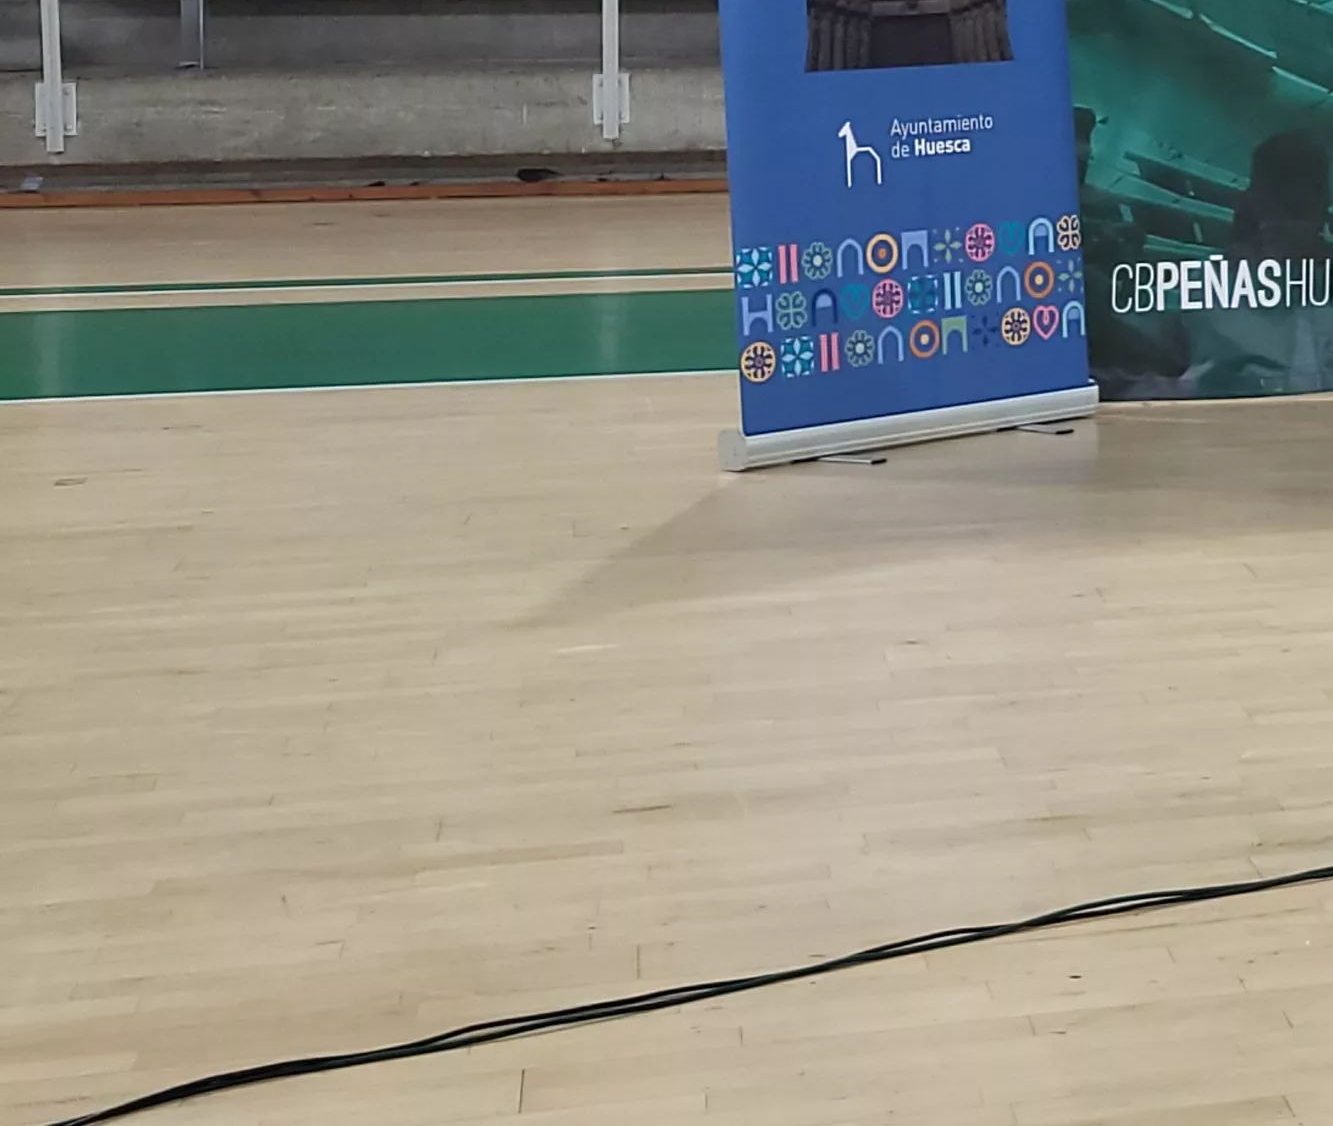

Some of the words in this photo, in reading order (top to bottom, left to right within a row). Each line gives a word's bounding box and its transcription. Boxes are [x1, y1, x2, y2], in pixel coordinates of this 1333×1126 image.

[890, 114, 993, 139] Ayuntamiento
[891, 141, 910, 158] de
[914, 137, 971, 157] Huesca
